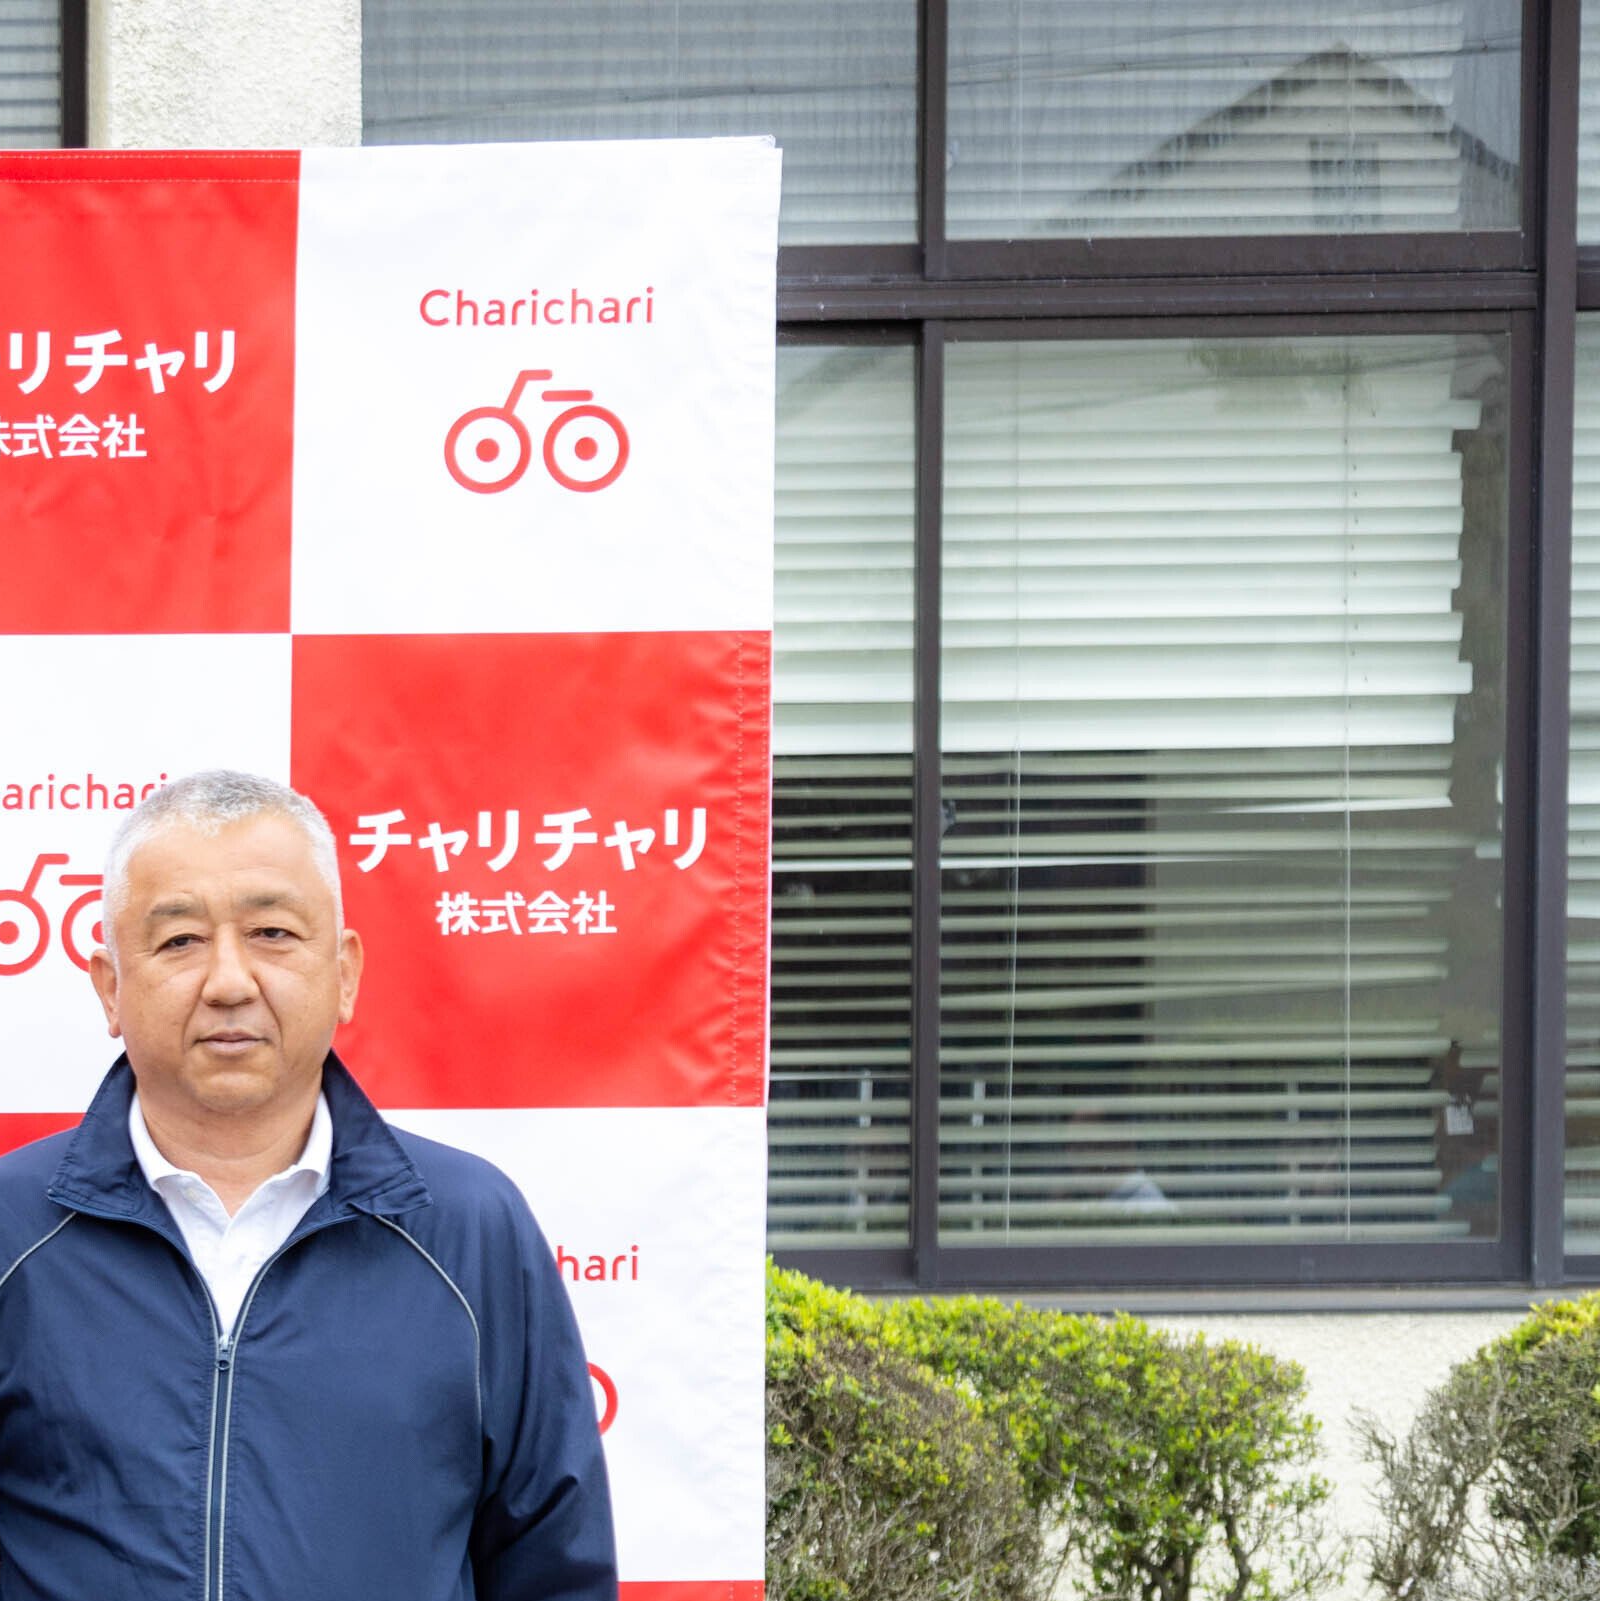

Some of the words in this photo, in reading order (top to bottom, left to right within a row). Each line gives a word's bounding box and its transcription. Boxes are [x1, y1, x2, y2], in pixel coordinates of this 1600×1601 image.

[419, 286, 654, 327] Charichari
[349, 807, 708, 873] チャリチャリ
[435, 889, 618, 936] 株式会社
